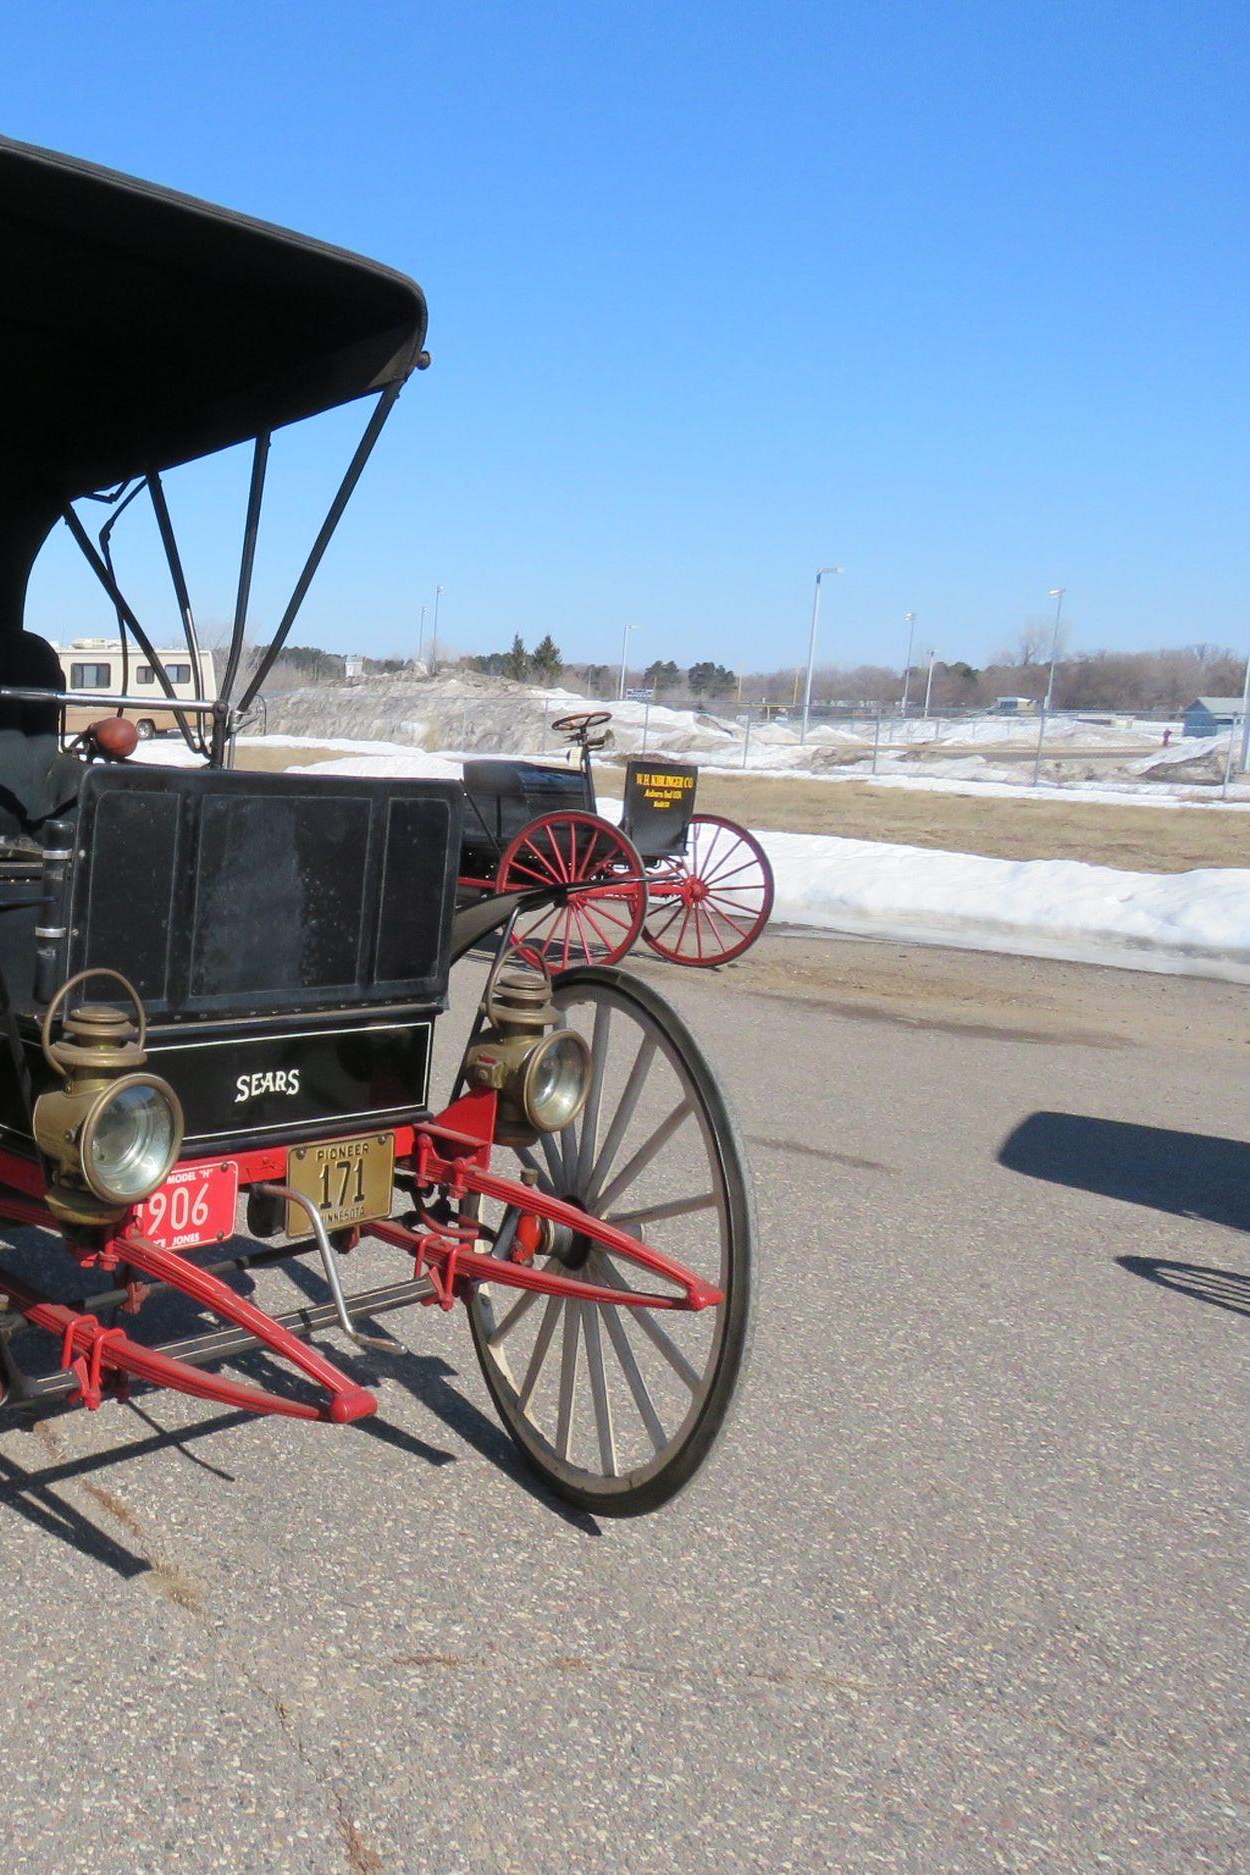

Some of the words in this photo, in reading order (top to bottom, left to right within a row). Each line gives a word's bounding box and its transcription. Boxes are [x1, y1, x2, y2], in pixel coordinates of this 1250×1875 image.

[234, 1068, 300, 1103] SEARS
[316, 1143, 369, 1161] PIONEER
[166, 1171, 197, 1185] MODEL
[199, 1168, 214, 1179] "H"
[319, 1157, 365, 1209] 171
[320, 1206, 365, 1225] INNESOTA
[172, 1232, 200, 1248] JONES
